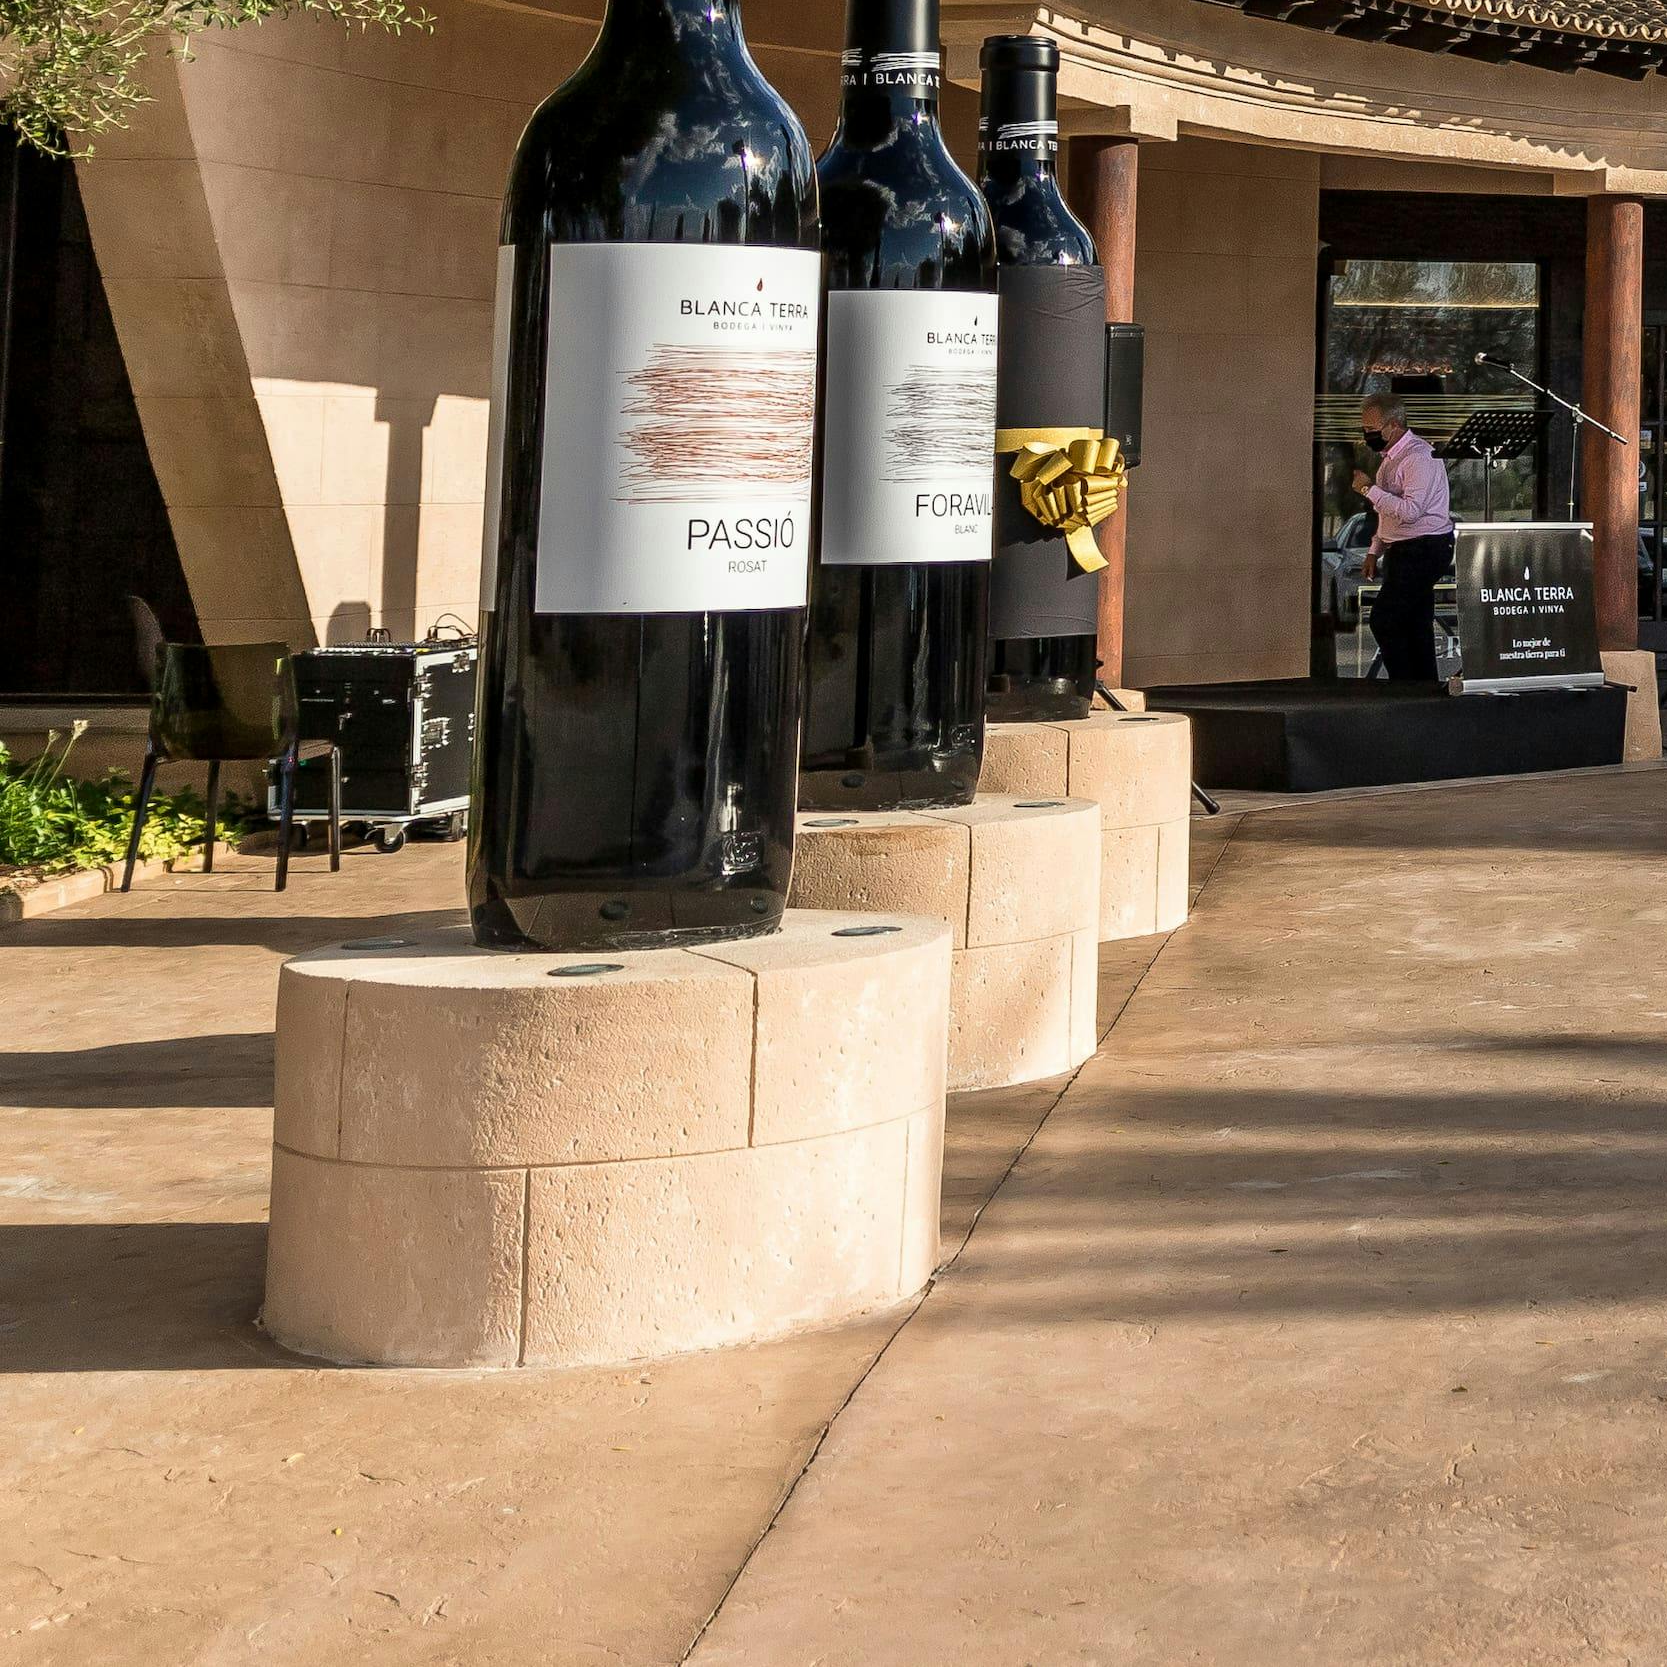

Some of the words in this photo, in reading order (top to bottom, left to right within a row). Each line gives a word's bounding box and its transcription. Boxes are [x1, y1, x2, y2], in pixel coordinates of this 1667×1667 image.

[875, 72, 934, 87] BLANCA
[996, 139, 1045, 152] BLANCA
[680, 299, 762, 317] BLANCA
[769, 301, 809, 319] TERRA
[713, 321, 757, 331] BODEGA
[927, 332, 978, 345] BLANCA
[915, 493, 994, 518] FORAVIL
[687, 510, 795, 550] PASSIÓ
[954, 523, 979, 535] BLANC
[728, 559, 768, 574] ROSAT
[1480, 587, 1532, 603] BLANCA
[1534, 586, 1574, 601] TERRA
[1493, 605, 1529, 615] BODEGA
[1538, 604, 1565, 614] VINYA
[1512, 638, 1522, 648] Lo
[1542, 636, 1552, 647] de
